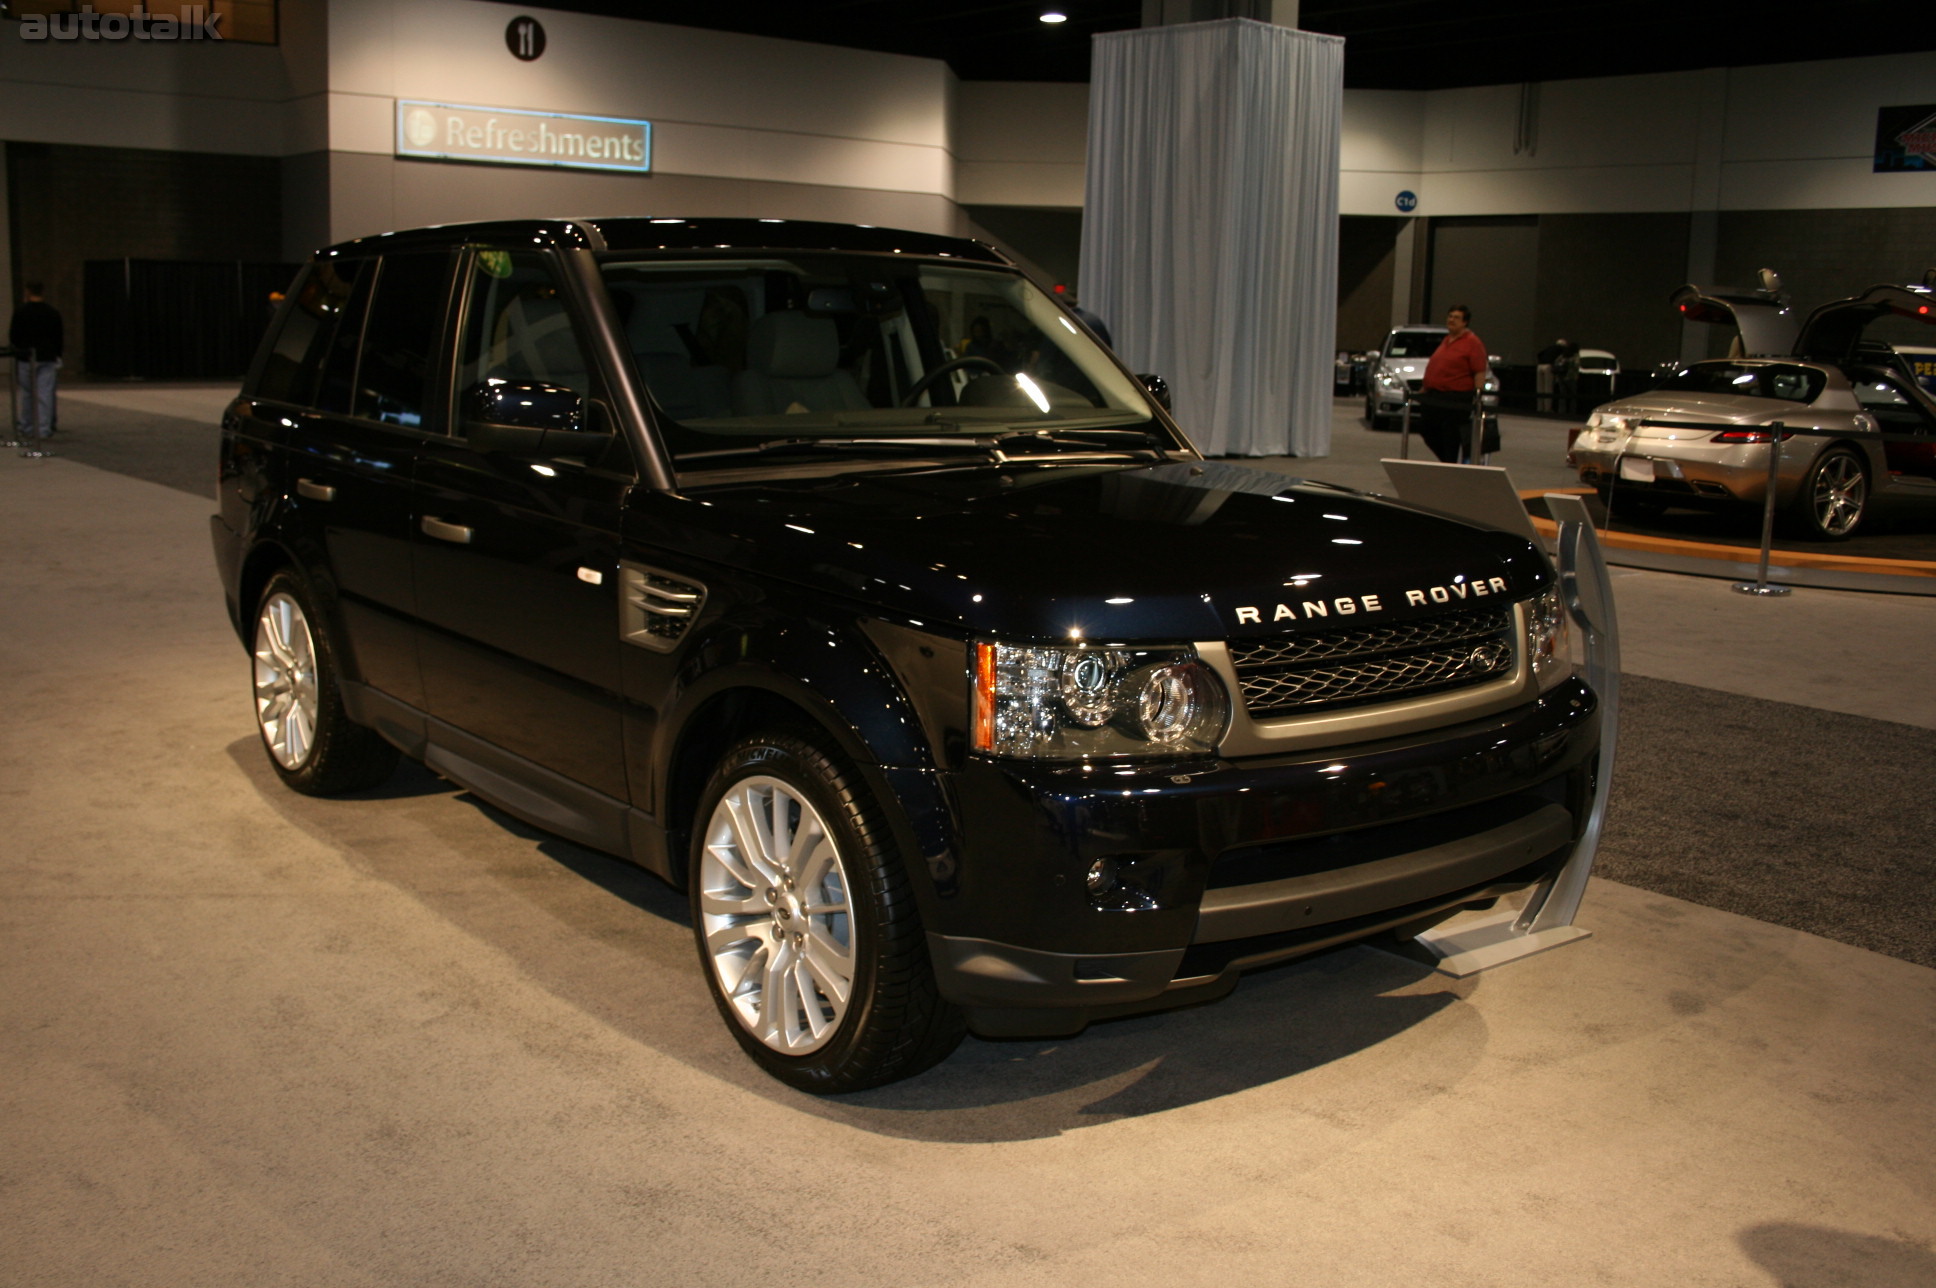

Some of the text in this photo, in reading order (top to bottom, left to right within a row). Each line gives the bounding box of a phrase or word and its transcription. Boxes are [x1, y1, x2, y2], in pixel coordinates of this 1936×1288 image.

[446, 116, 644, 161] Refreshments
[1235, 577, 1508, 625] RANGE ROVER
